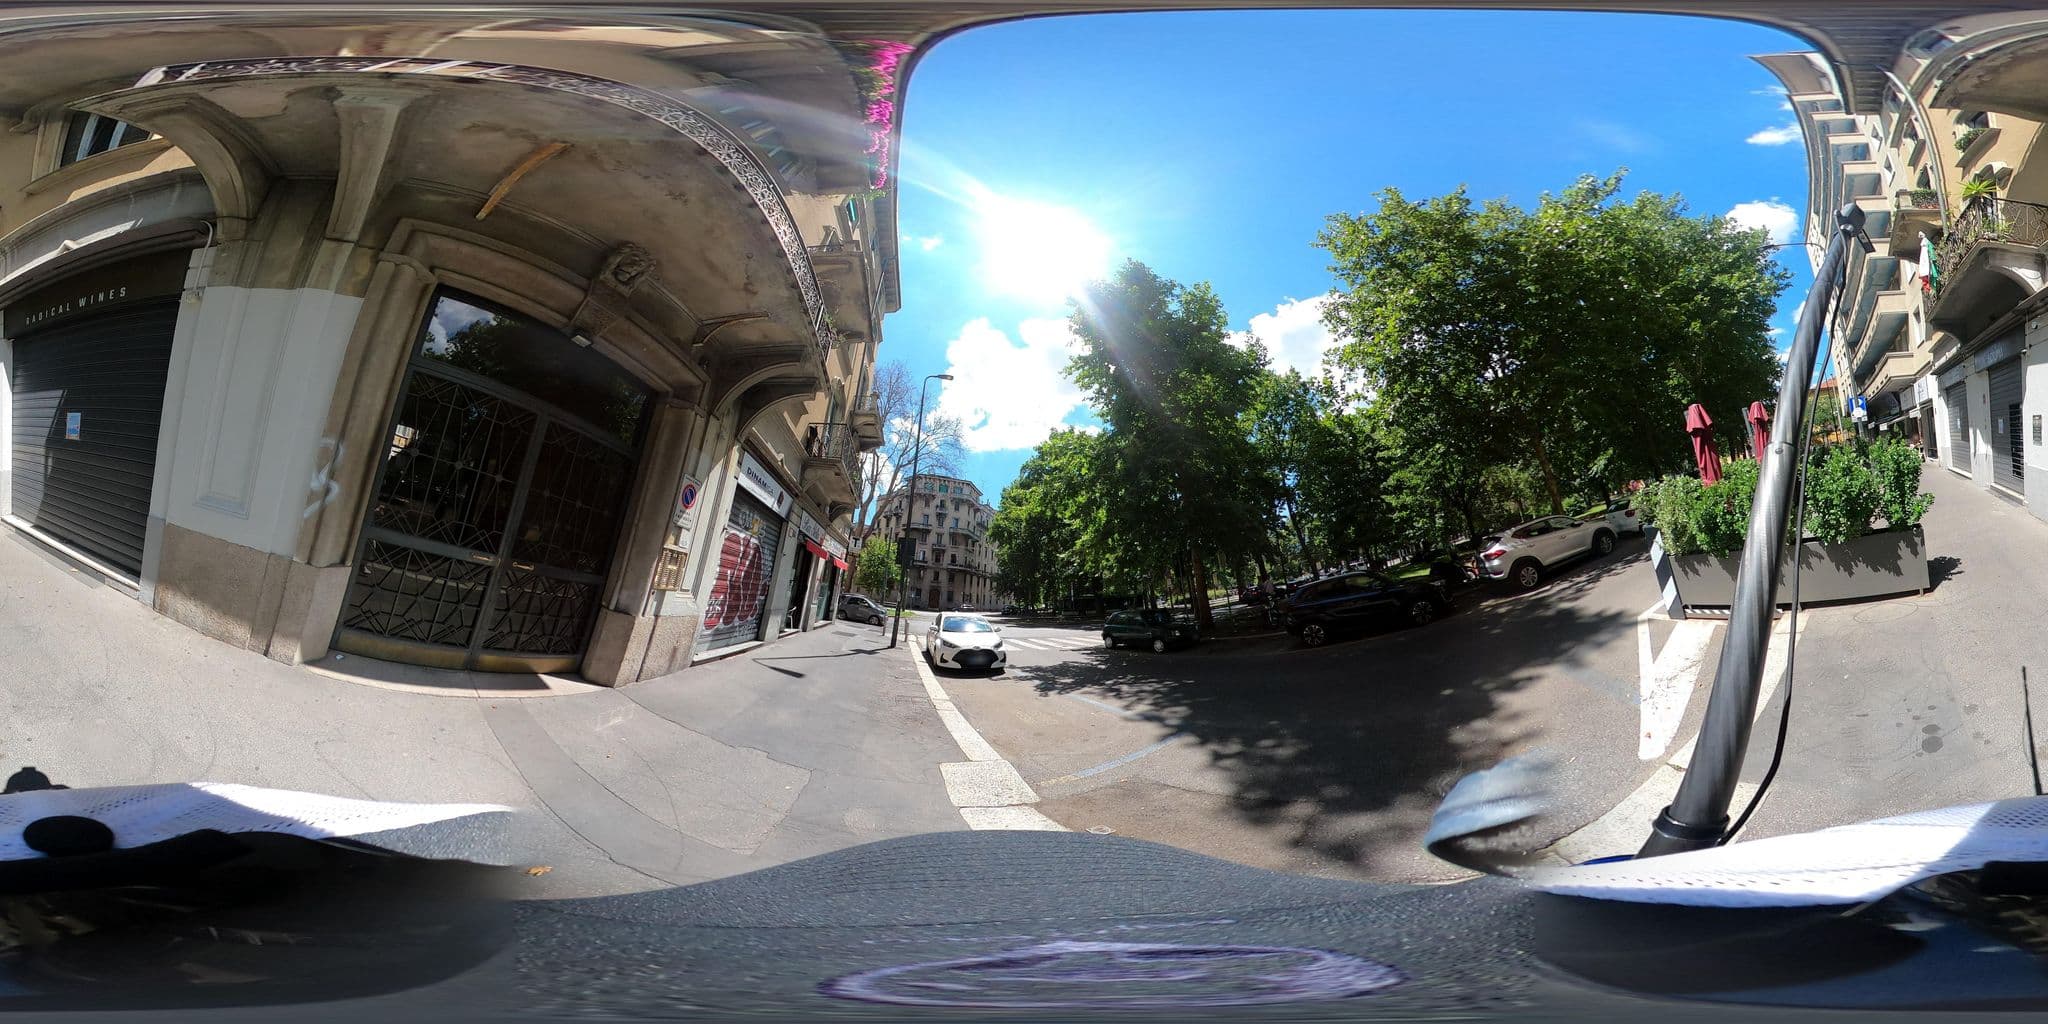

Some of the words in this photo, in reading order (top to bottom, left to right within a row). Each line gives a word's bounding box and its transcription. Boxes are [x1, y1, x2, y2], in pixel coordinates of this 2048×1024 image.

[26, 302, 70, 325] RADICAL
[79, 287, 126, 307] WINES
[853, 536, 860, 548] T
